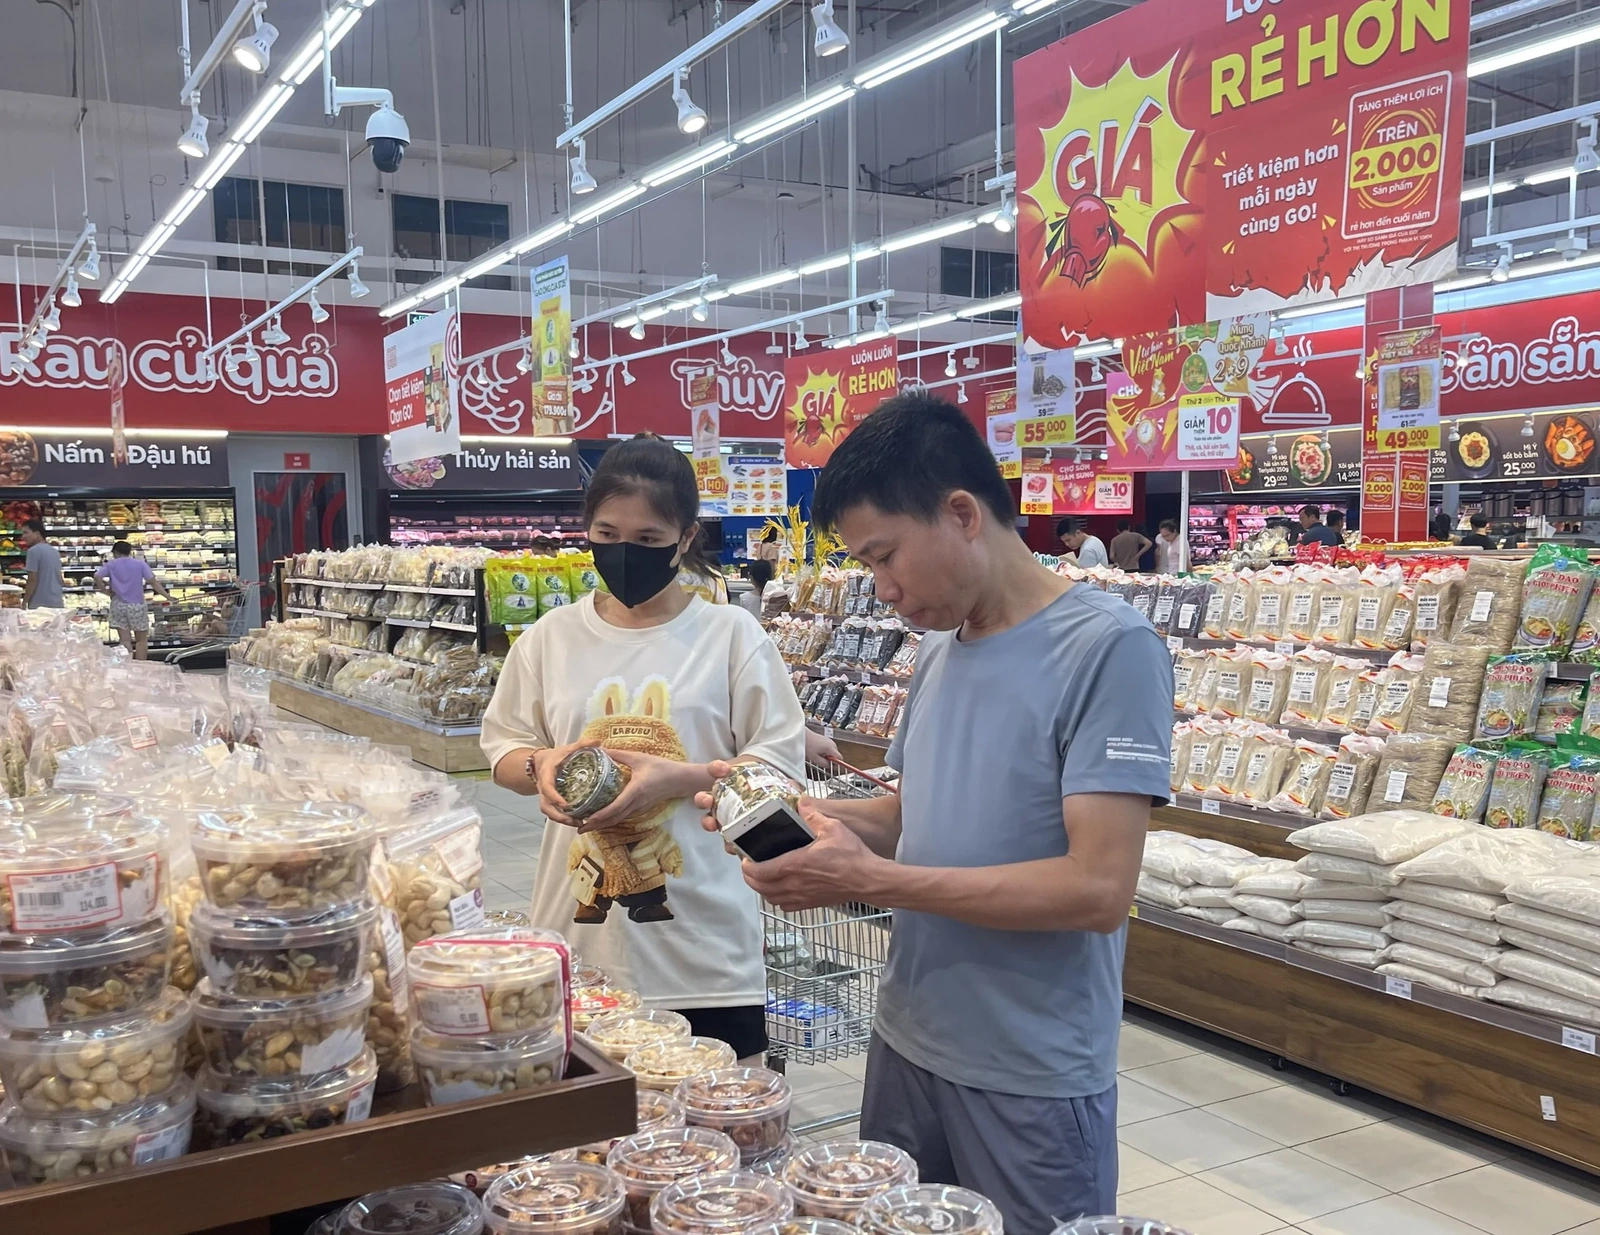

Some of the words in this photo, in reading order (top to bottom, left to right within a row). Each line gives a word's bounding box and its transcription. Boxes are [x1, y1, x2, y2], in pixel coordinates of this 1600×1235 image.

[1211, 13, 1285, 116] RẺ
[1297, 0, 1450, 87] HƠN
[1358, 99, 1382, 114] TĂNG
[1383, 92, 1408, 108] THÊM
[1426, 84, 1443, 98] ÍCH
[1376, 120, 1418, 144] TRÊN
[1053, 96, 1163, 206] GIÁ
[1353, 142, 1437, 183] 2.000
[1222, 163, 1254, 189] Tiết
[1258, 156, 1299, 179] kiệm
[1304, 144, 1339, 166] hơn
[1239, 185, 1270, 211] mỗi
[1274, 177, 1318, 202] ngày
[1372, 184, 1388, 196] Sản
[1389, 179, 1413, 196] phẩm
[1239, 216, 1280, 237] cùng
[1284, 202, 1318, 225] GO!
[1359, 218, 1375, 230] hơn
[1376, 213, 1392, 226] đến
[1412, 208, 1431, 221] năm
[1231, 322, 1254, 337] Mừng
[851, 349, 873, 366] LUÔN
[874, 344, 893, 361] LUÔN
[1217, 340, 1239, 354] Quốc
[1240, 336, 1266, 350] Khánh
[1466, 345, 1515, 384] ăn
[1527, 324, 1600, 377] sẵn
[0, 331, 117, 381] Rau
[139, 334, 209, 383] củ
[226, 340, 330, 395] quả
[1130, 345, 1150, 377] Việt
[1151, 350, 1174, 369] Nam
[389, 386, 402, 407] Chọn
[410, 377, 425, 400] kiệm
[677, 364, 784, 412] Thủy
[848, 366, 867, 396] RẺ
[868, 367, 896, 392] HƠN
[802, 385, 837, 421] GIÁ
[390, 407, 403, 428] Chọn
[402, 403, 413, 421] GO!
[1184, 415, 1205, 429] GIẢM
[1024, 420, 1067, 443] 55.000
[1385, 429, 1429, 449] 49.000
[45, 439, 105, 464] Nấm
[127, 444, 175, 469] Đậu
[182, 443, 212, 465] hũ
[1434, 449, 1447, 457] Súp
[1503, 451, 1513, 460] sốt
[1513, 451, 1522, 459] bò
[1524, 443, 1532, 451] Mì
[453, 448, 501, 472] Thủy
[505, 448, 535, 469] hải
[538, 449, 571, 470] sản
[1432, 457, 1448, 465] 270g
[1503, 461, 1536, 476] 25.000
[1263, 475, 1288, 488] 29.000
[1337, 471, 1360, 482] 14.000
[1366, 483, 1392, 493] 2.000
[1402, 481, 1425, 491] 2.000
[612, 727, 651, 736] LABUBU
